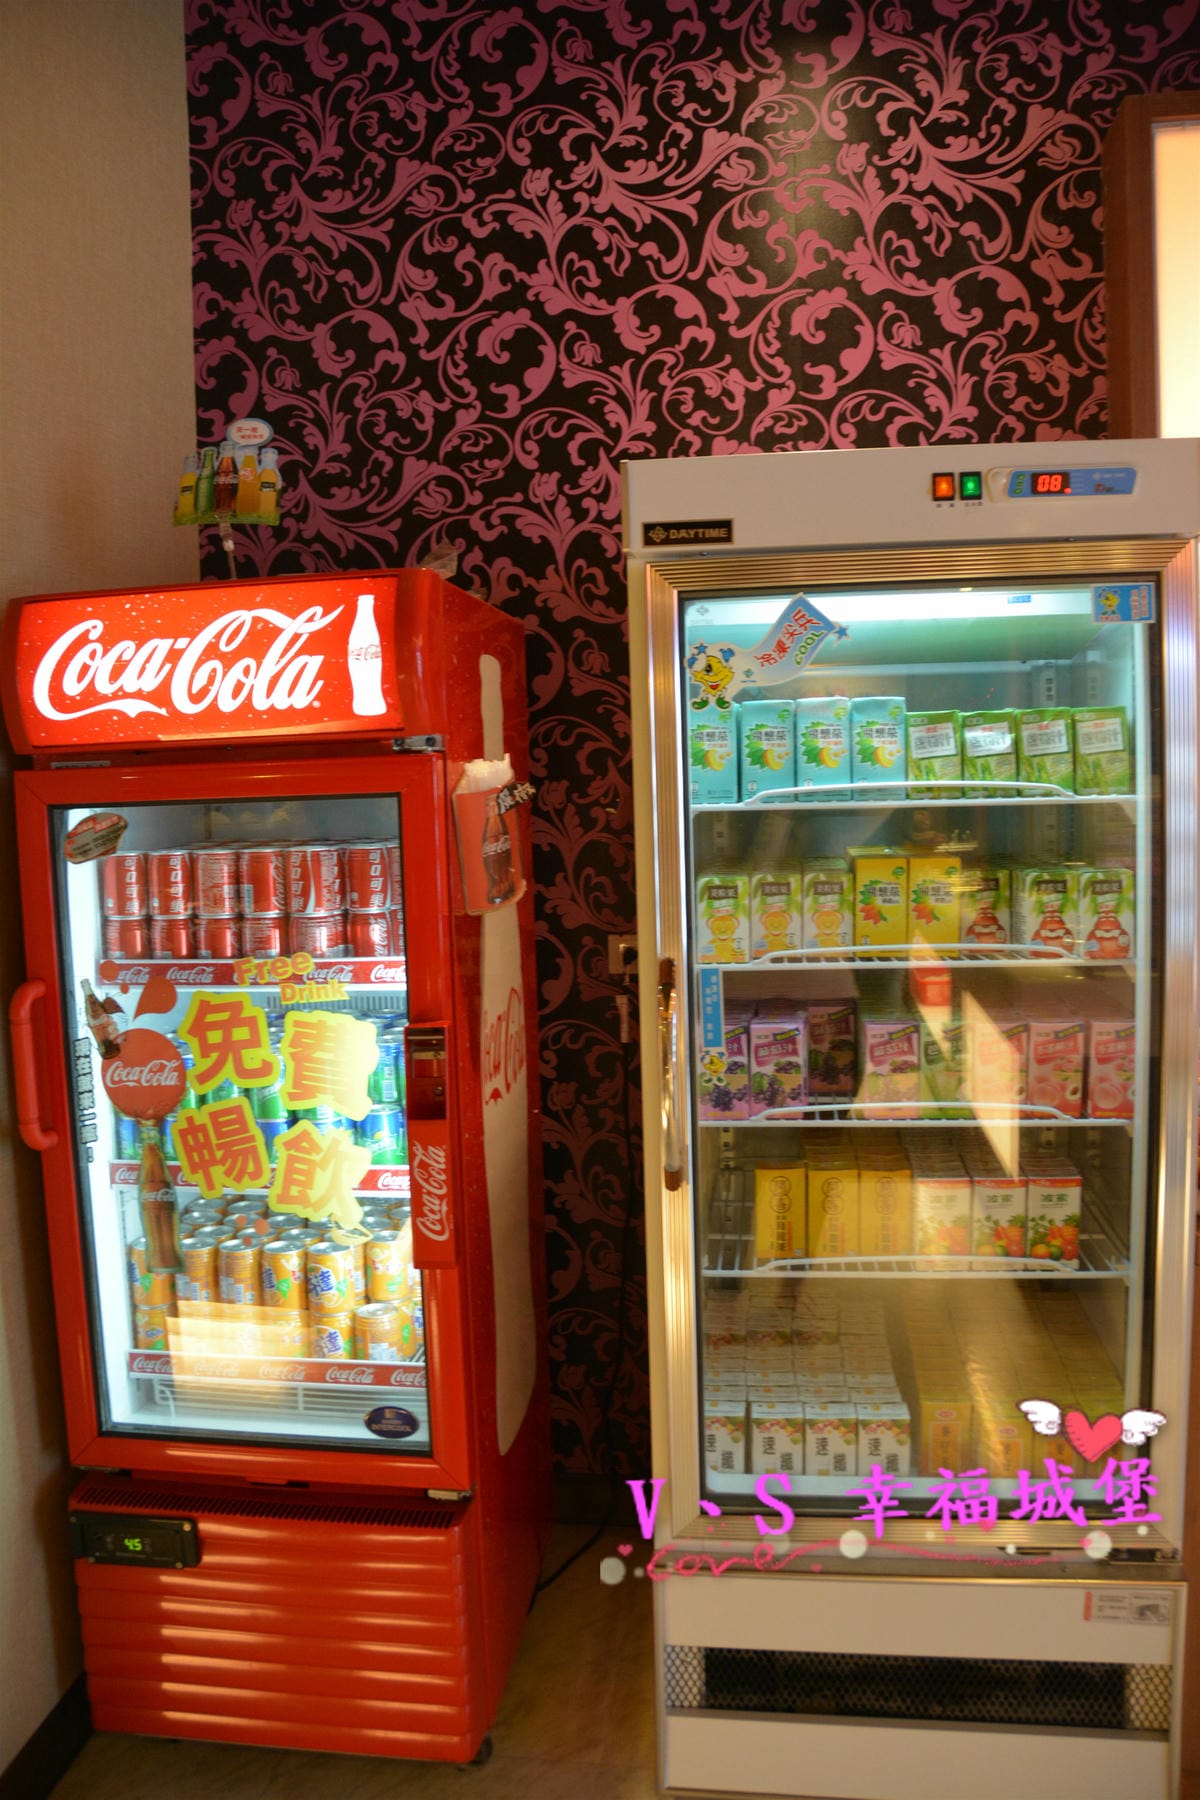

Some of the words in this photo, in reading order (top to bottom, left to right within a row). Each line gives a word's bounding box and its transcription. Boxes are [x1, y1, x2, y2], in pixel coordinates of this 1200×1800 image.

[1037, 474, 1062, 492] 08
[669, 527, 729, 540] DAYTIME
[33, 604, 346, 721] Coca-Cola
[793, 629, 826, 666] COOL
[369, 850, 385, 909] 可口可樂
[166, 965, 215, 983] Coca-Cola
[233, 952, 312, 985] Free
[281, 981, 346, 1002] Drink
[106, 1059, 180, 1088] Coca-Cola
[186, 998, 374, 1117] 免費
[179, 1103, 367, 1224] 暢飲
[412, 1141, 449, 1242] Coca-Cola
[325, 1366, 374, 1384] Coca-Cola
